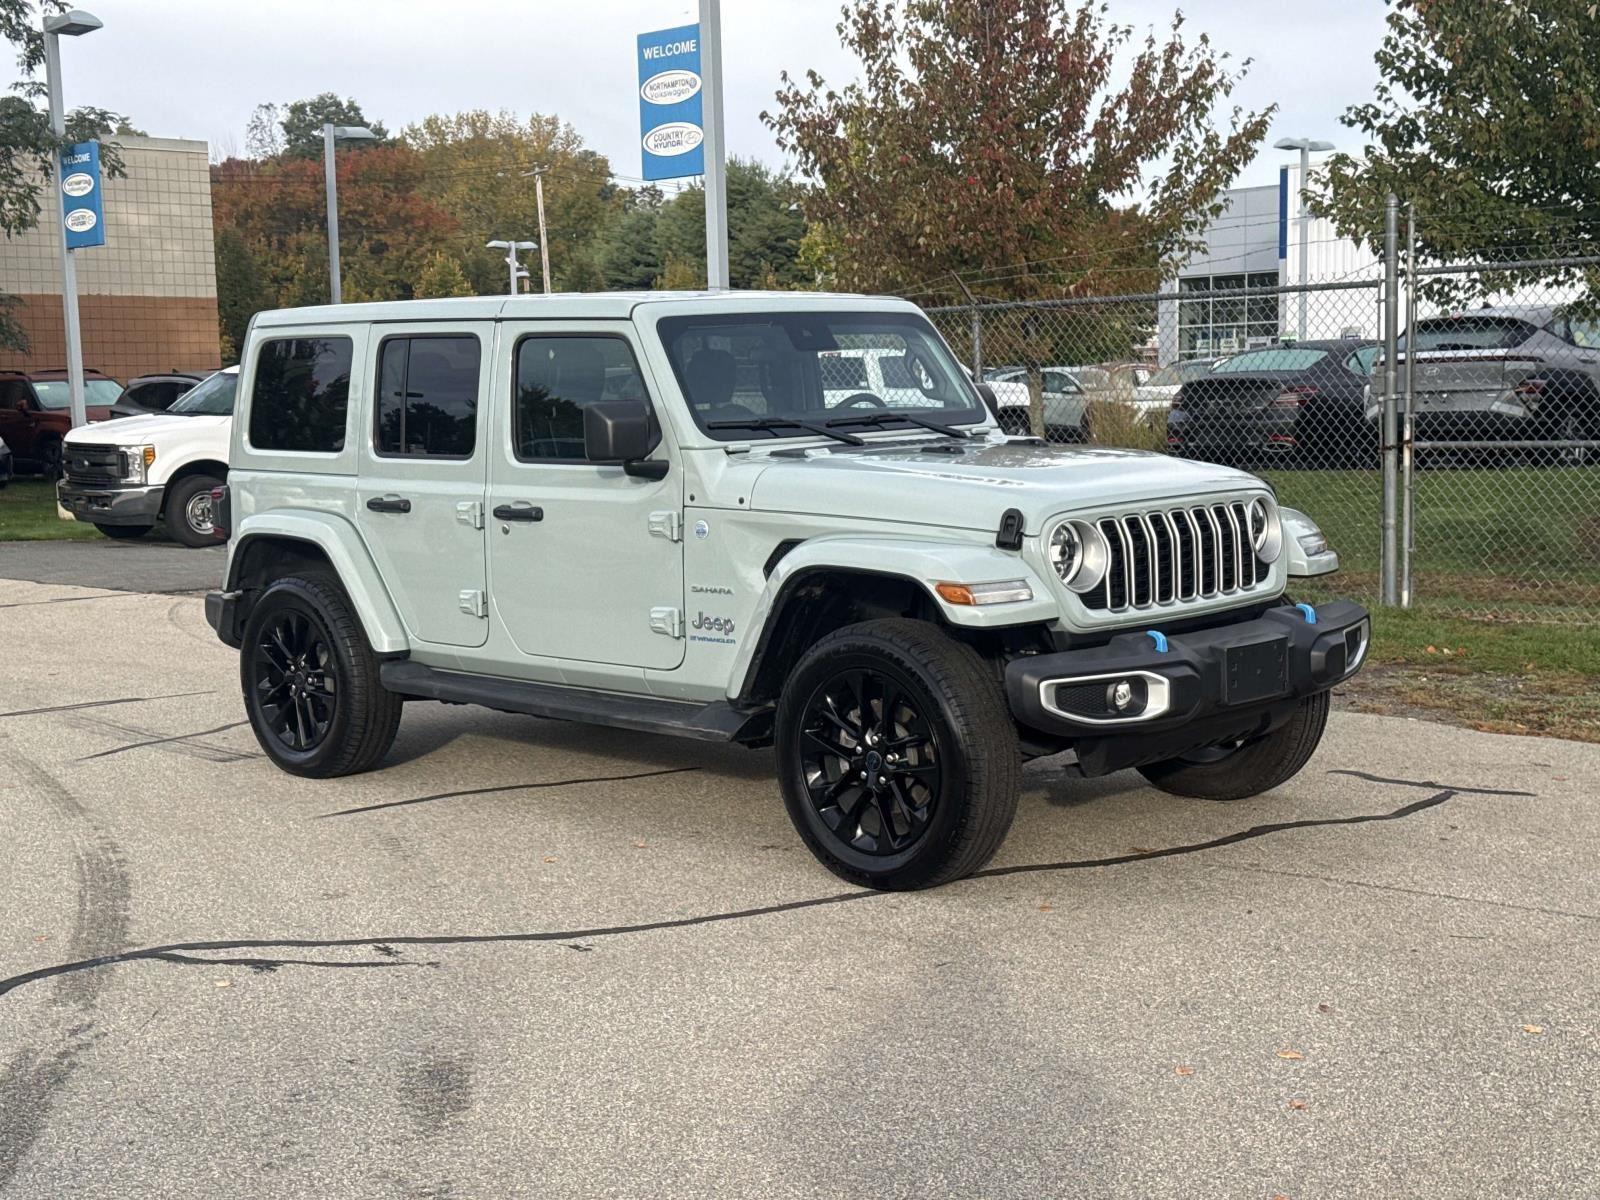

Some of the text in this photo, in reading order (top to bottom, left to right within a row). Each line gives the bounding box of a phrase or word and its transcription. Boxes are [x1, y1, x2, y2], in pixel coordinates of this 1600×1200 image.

[643, 40, 697, 60] WELCOME
[649, 78, 690, 91] NORTHAMPTON
[650, 88, 690, 98] Volkswagen
[653, 131, 684, 142] COUNTRY
[653, 140, 683, 149] HYUNDAI
[691, 586, 735, 596] SAHARA
[691, 611, 736, 635] Jeep
[696, 635, 736, 645] WRANGLER
